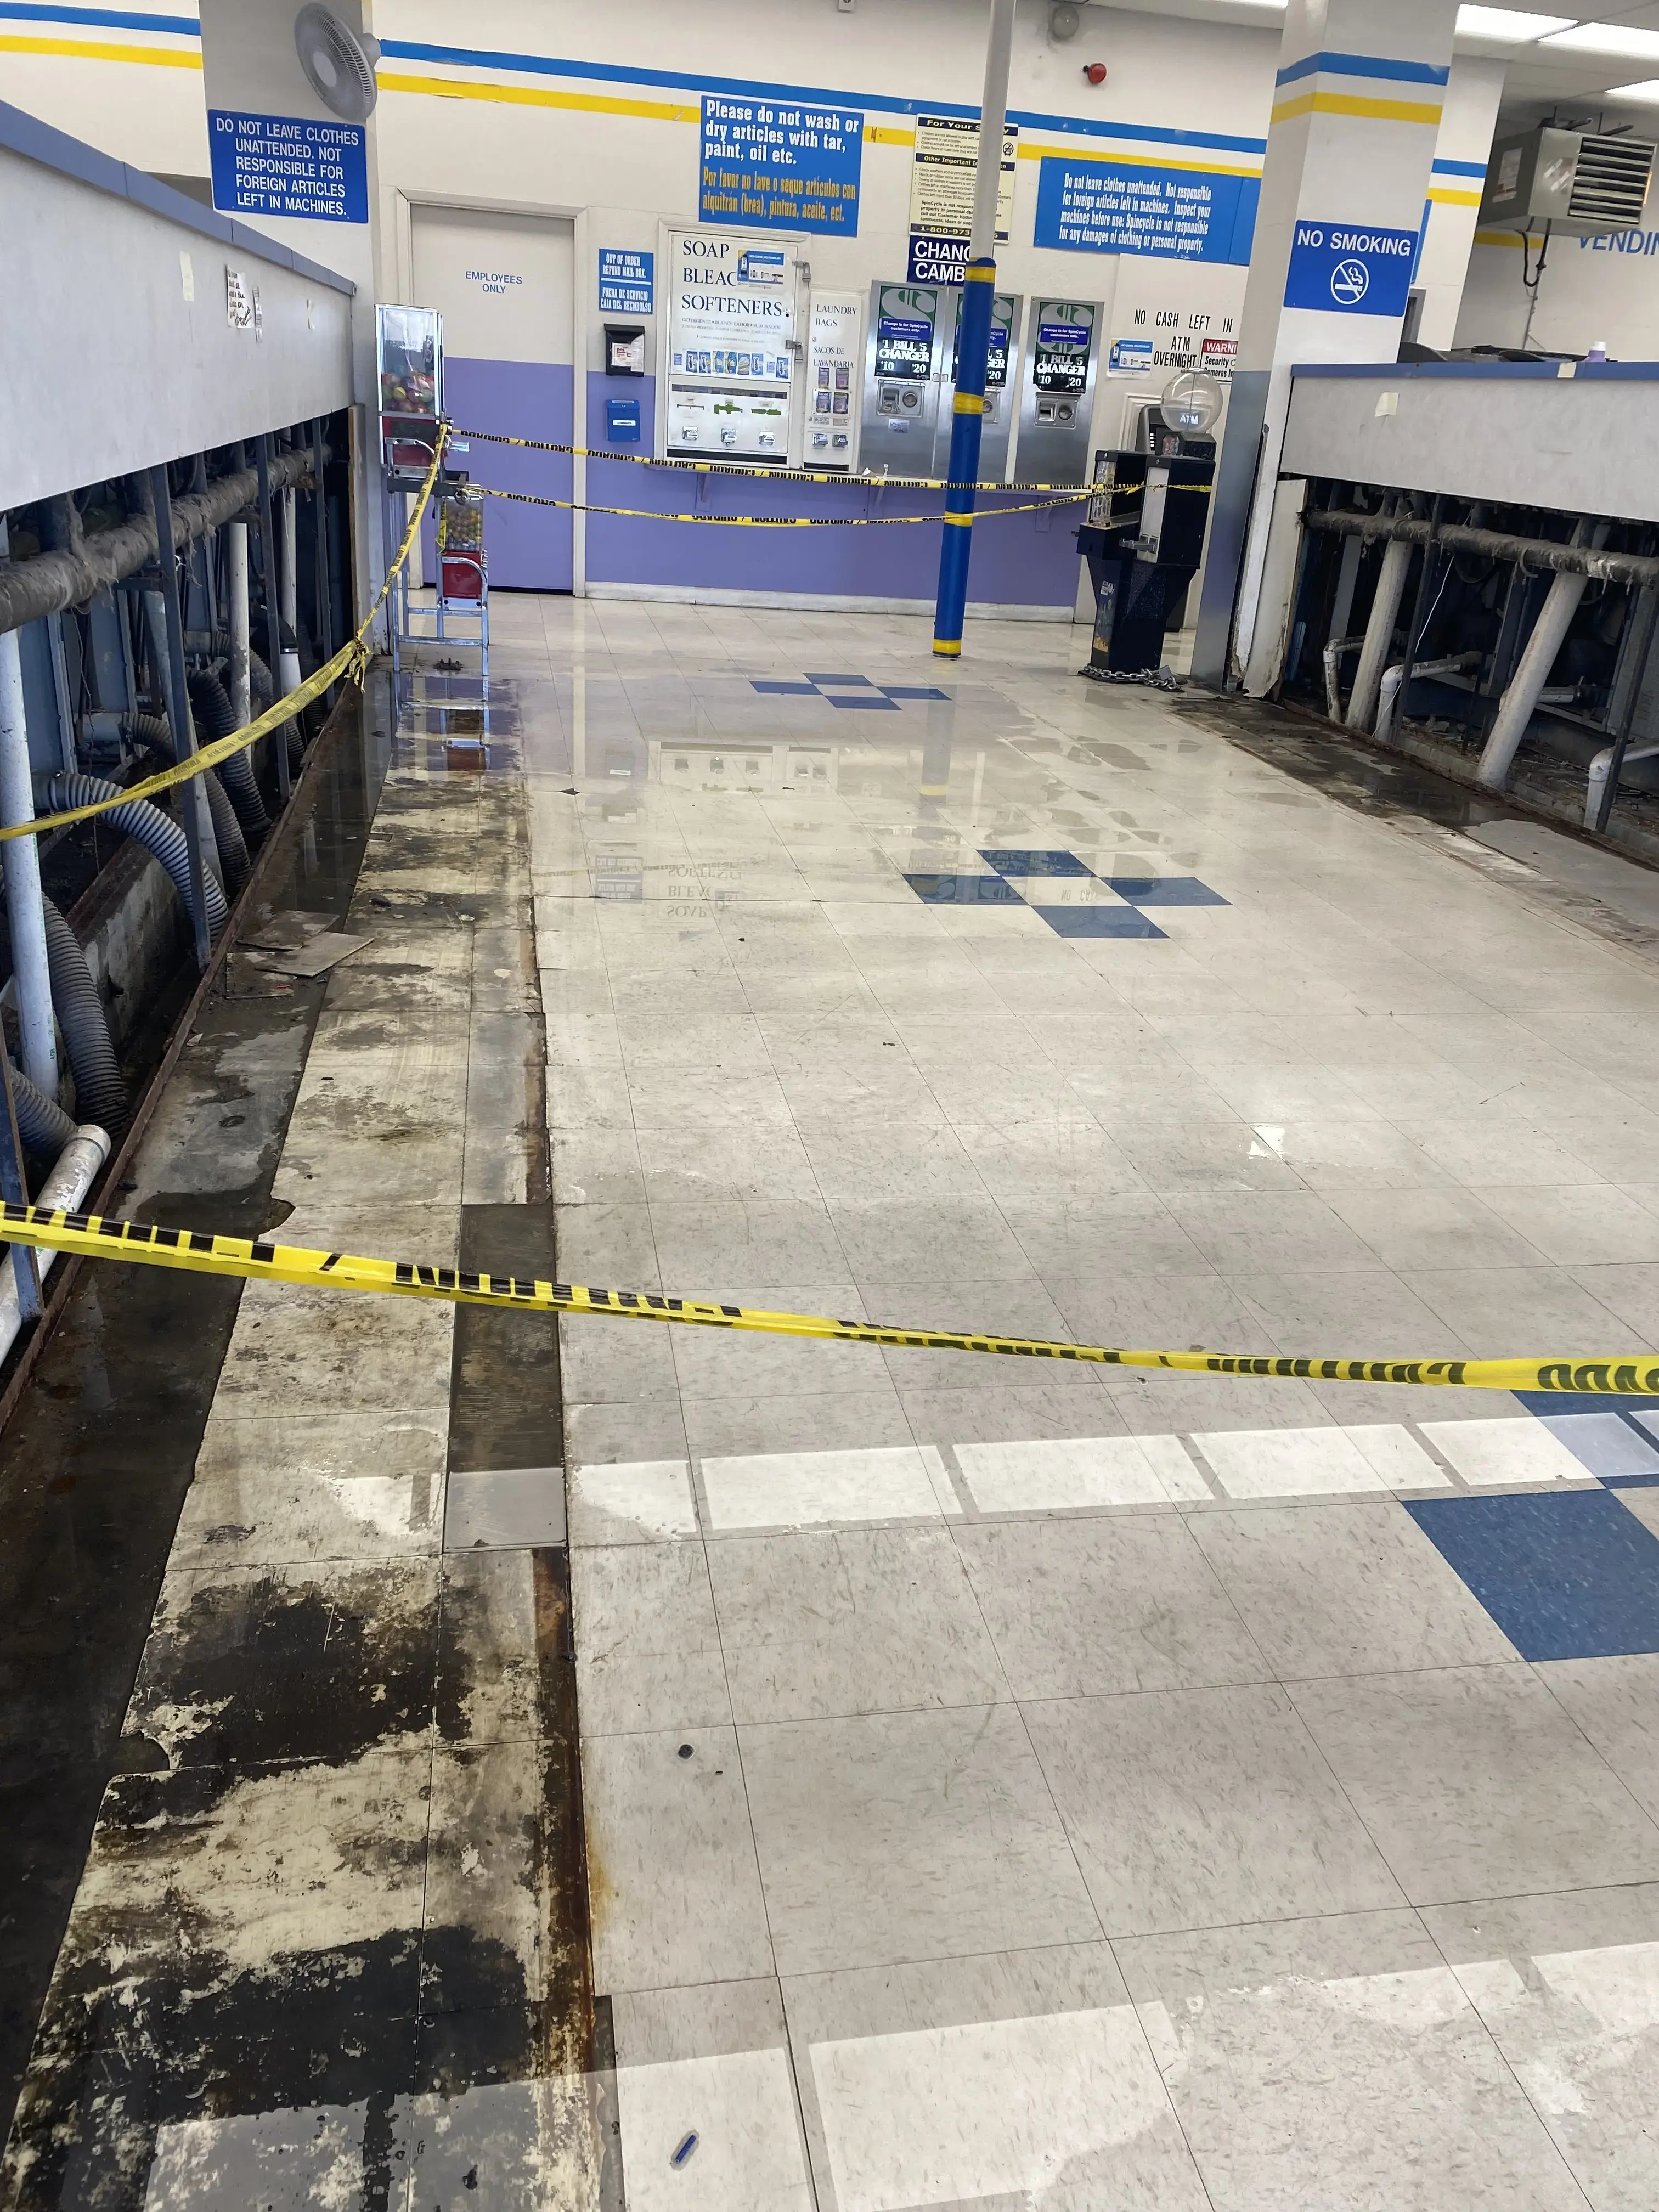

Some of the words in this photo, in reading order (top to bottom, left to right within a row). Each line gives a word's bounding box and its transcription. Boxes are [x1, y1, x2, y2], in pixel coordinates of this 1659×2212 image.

[706, 99, 752, 121] Please
[757, 105, 773, 123] do
[778, 110, 800, 127] not
[805, 114, 840, 131] wash
[845, 118, 859, 133] or
[216, 117, 233, 132] DO
[238, 120, 262, 136] NOT
[266, 123, 301, 139] LEAVE
[306, 127, 359, 145] CLOTHES
[948, 122, 973, 130] Your
[706, 120, 727, 141] dry
[732, 124, 784, 144] articles
[789, 130, 818, 148] with
[823, 133, 845, 153] tar,
[235, 138, 314, 159] UNATTENDED.
[319, 147, 342, 161] NOT
[704, 140, 744, 161] paint,
[749, 144, 767, 162] oil
[772, 148, 797, 165] etc.
[236, 156, 315, 177] RESPONSIBLE
[320, 165, 343, 180] FOR
[942, 157, 971, 166] Important
[236, 174, 286, 191] FOREIGN
[291, 180, 345, 198] ARTICLES
[703, 166, 716, 187] Por
[741, 174, 751, 190] no
[754, 171, 770, 191] lave
[773, 177, 777, 193] o
[842, 183, 856, 200] con
[1064, 173, 1072, 188] Do
[1074, 176, 1084, 189] not
[1086, 176, 1102, 190] leave
[1104, 177, 1125, 193] clothes
[1127, 180, 1161, 196] unattended.
[1166, 182, 1176, 197] Not
[1177, 185, 1211, 201] responsible
[237, 192, 264, 207] LEFT
[269, 195, 281, 209] IN
[285, 196, 347, 215] MACHINES.
[1063, 190, 1071, 205] for
[1073, 191, 1093, 210] foreign
[1096, 193, 1118, 210] articles
[1120, 196, 1131, 211] left
[1132, 196, 1138, 211] in
[1140, 198, 1170, 214] machines.
[1174, 201, 1197, 218] Inspect
[1198, 206, 1211, 219] your
[920, 225, 970, 235] 1-800-973
[1060, 210, 1090, 225] machines
[1091, 211, 1110, 227] before
[1156, 216, 1163, 230] is
[1164, 218, 1174, 232] not
[1175, 220, 1209, 236] responsible
[1059, 224, 1068, 240] for
[1069, 229, 1080, 244] any
[1082, 227, 1108, 247] damages
[1110, 228, 1117, 241] of
[1118, 230, 1142, 250] clothing
[1144, 236, 1150, 247] or
[1152, 235, 1176, 250] personal
[1297, 229, 1323, 247] NO
[1330, 232, 1411, 256] SMOKING
[682, 240, 729, 258] SOAP
[915, 241, 970, 261] CHAN
[606, 253, 616, 264] OUT
[617, 255, 623, 264] OF
[625, 255, 640, 266] ORDER
[466, 271, 522, 284] EMPLOYEES
[602, 264, 621, 275] REFUND
[623, 266, 634, 277] MAIL
[682, 268, 737, 286] BLEAC
[916, 262, 966, 281] CAMB
[482, 284, 506, 294] ONLY
[602, 287, 618, 298] FUERA
[619, 289, 625, 298] DE
[627, 290, 648, 301] SERVICIO
[601, 298, 612, 309] CAJA
[613, 300, 622, 309] DEL
[623, 300, 651, 312] REEMBOLSO
[682, 294, 782, 316] SOFTENERS
[816, 304, 857, 315] LAUNDRY
[815, 318, 837, 327] BAGS
[1135, 309, 1146, 324] NO
[1156, 311, 1179, 327] CASH
[1189, 314, 1211, 330] LEFT
[1223, 318, 1233, 332] IN
[814, 346, 834, 354] SACOS
[893, 340, 916, 351] BILL
[1171, 336, 1190, 351] ATM
[1207, 343, 1236, 353] WARNI
[879, 348, 930, 362] CHANGER
[1051, 354, 1073, 365] BILL
[1154, 351, 1197, 368] OVERNIGHT
[1205, 356, 1229, 368] Security
[1036, 363, 1086, 376] CHANGER
[1180, 414, 1198, 424] ATM
